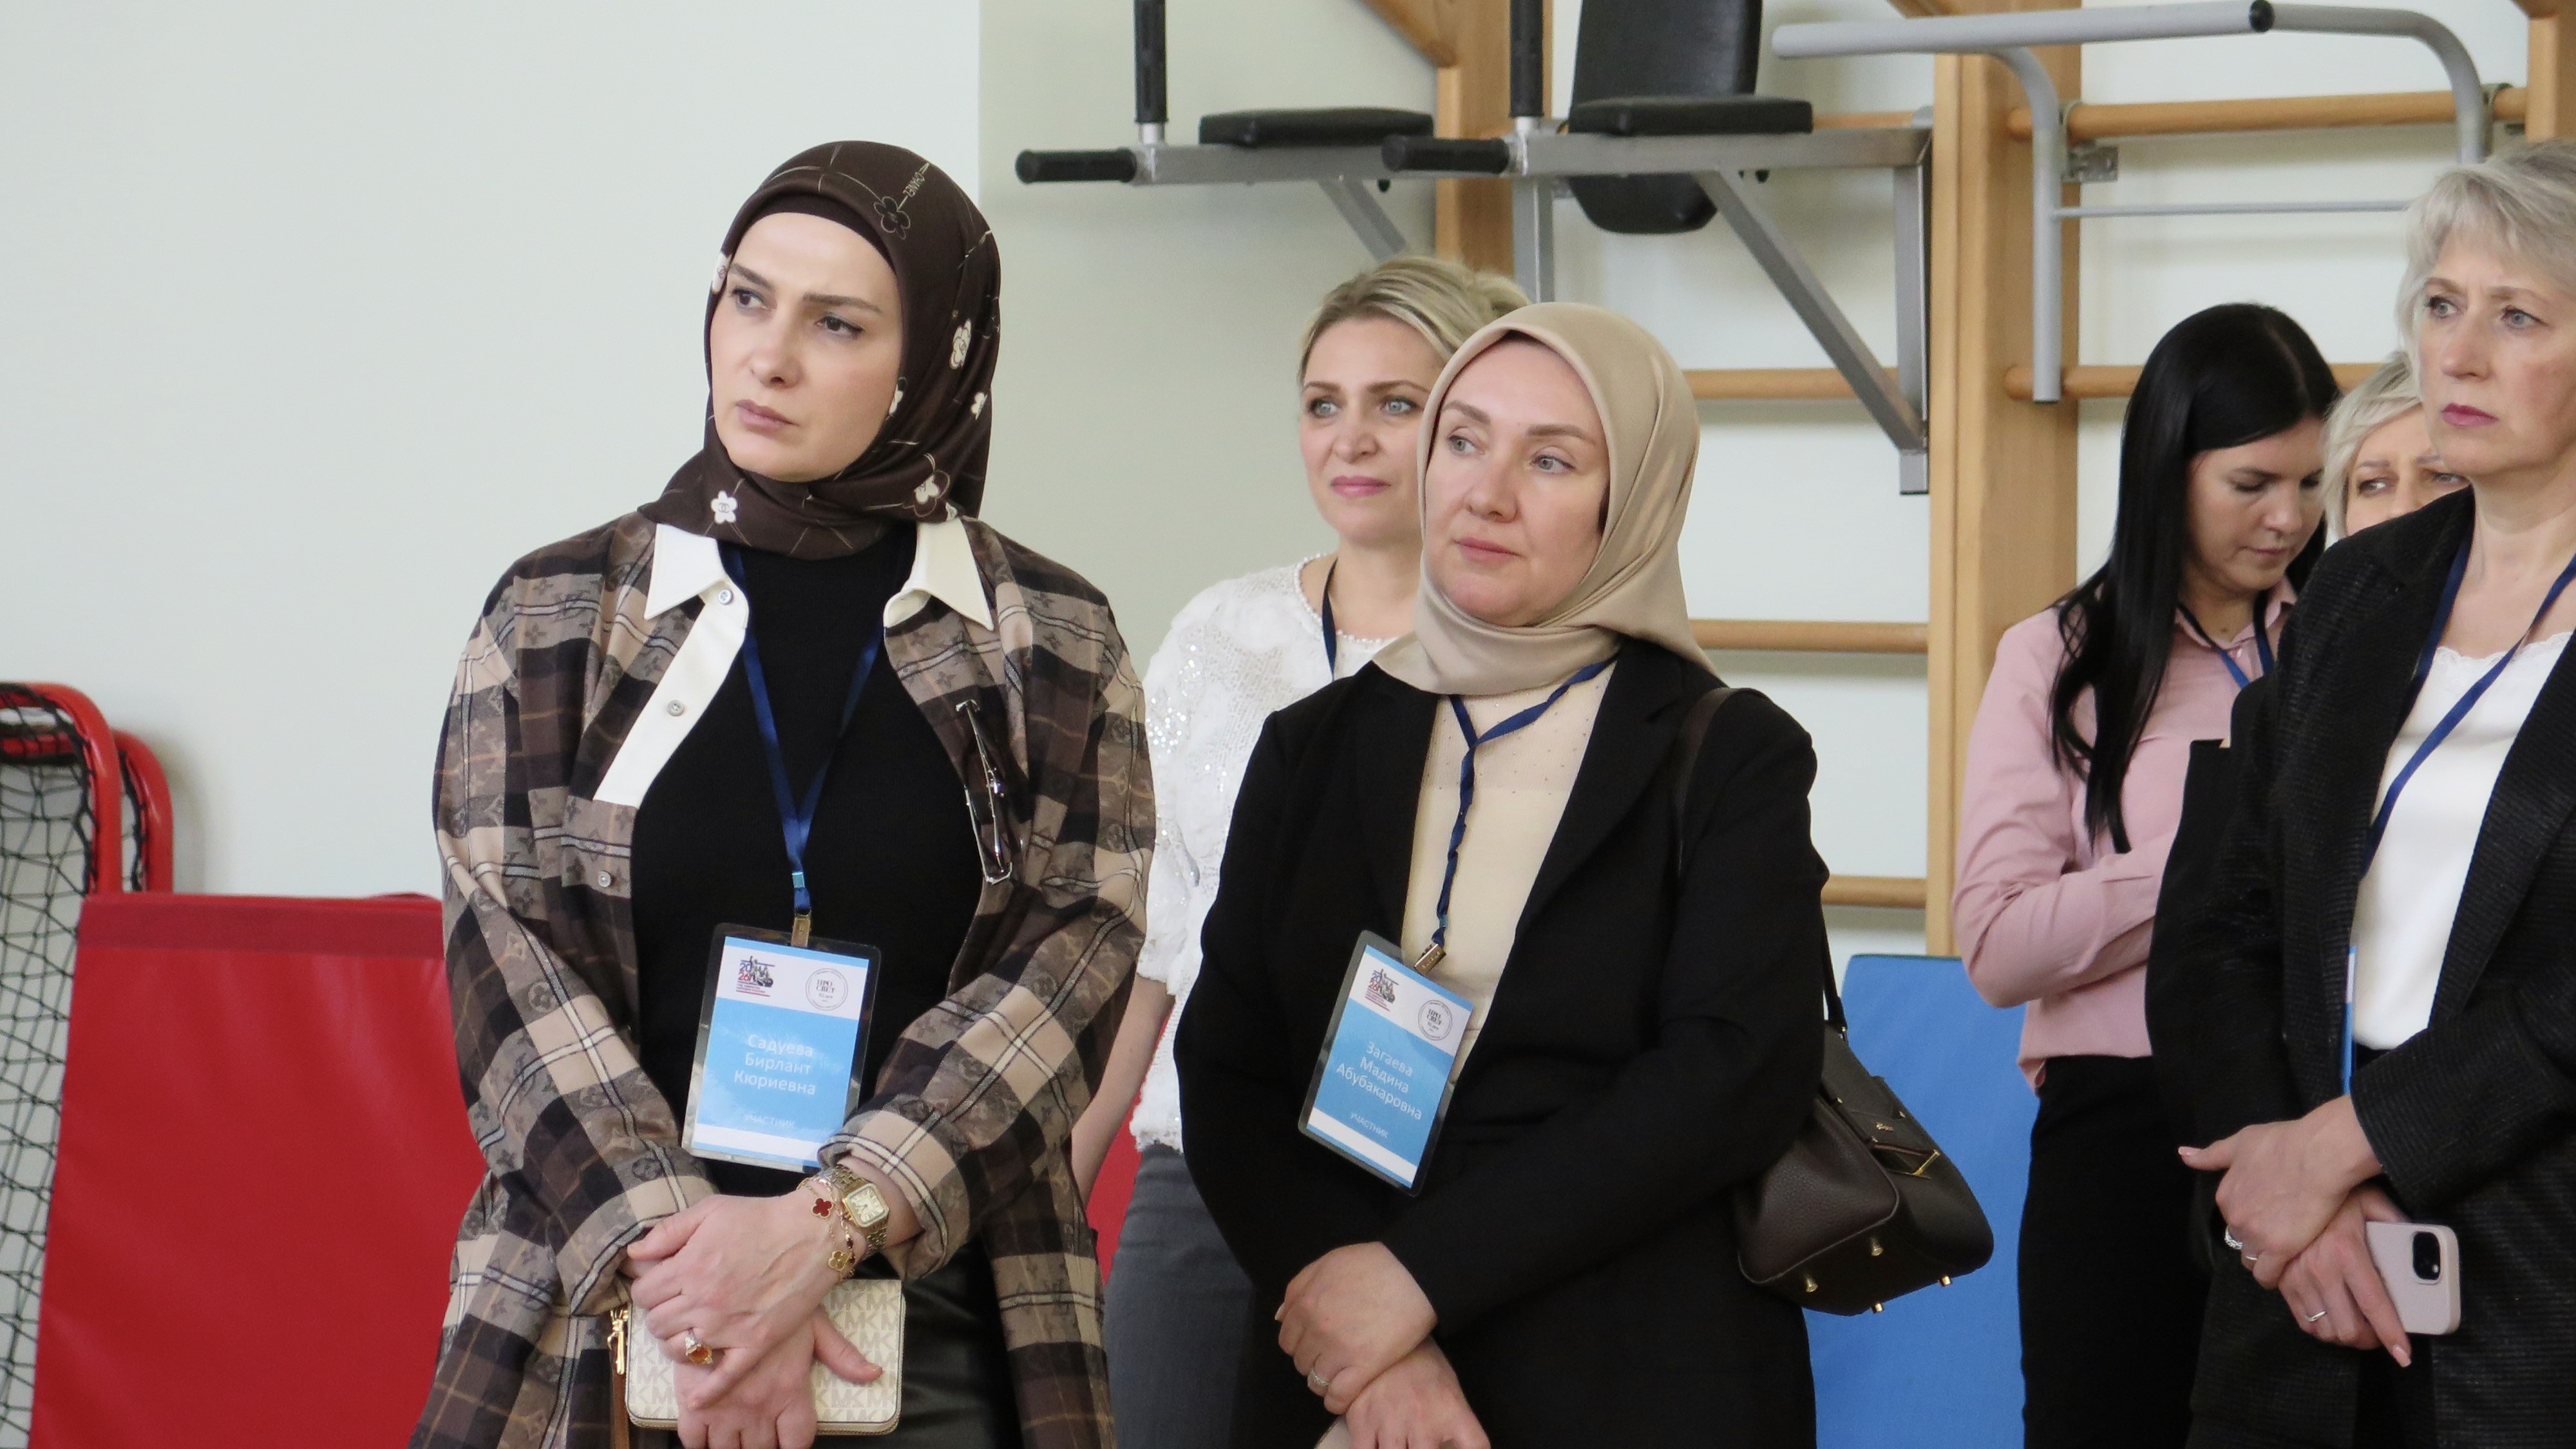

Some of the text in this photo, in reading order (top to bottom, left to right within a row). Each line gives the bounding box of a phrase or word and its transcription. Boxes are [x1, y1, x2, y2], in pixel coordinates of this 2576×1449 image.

[748, 1033, 814, 1057] Садуева
[744, 1052, 811, 1075] Бирлант
[1366, 1041, 1413, 1077] Загаева
[734, 1069, 816, 1095] Кюриевна
[1360, 1056, 1410, 1094] Мадина
[1336, 1063, 1423, 1120] Абубакаровна
[859, 1331, 895, 1350] MK
